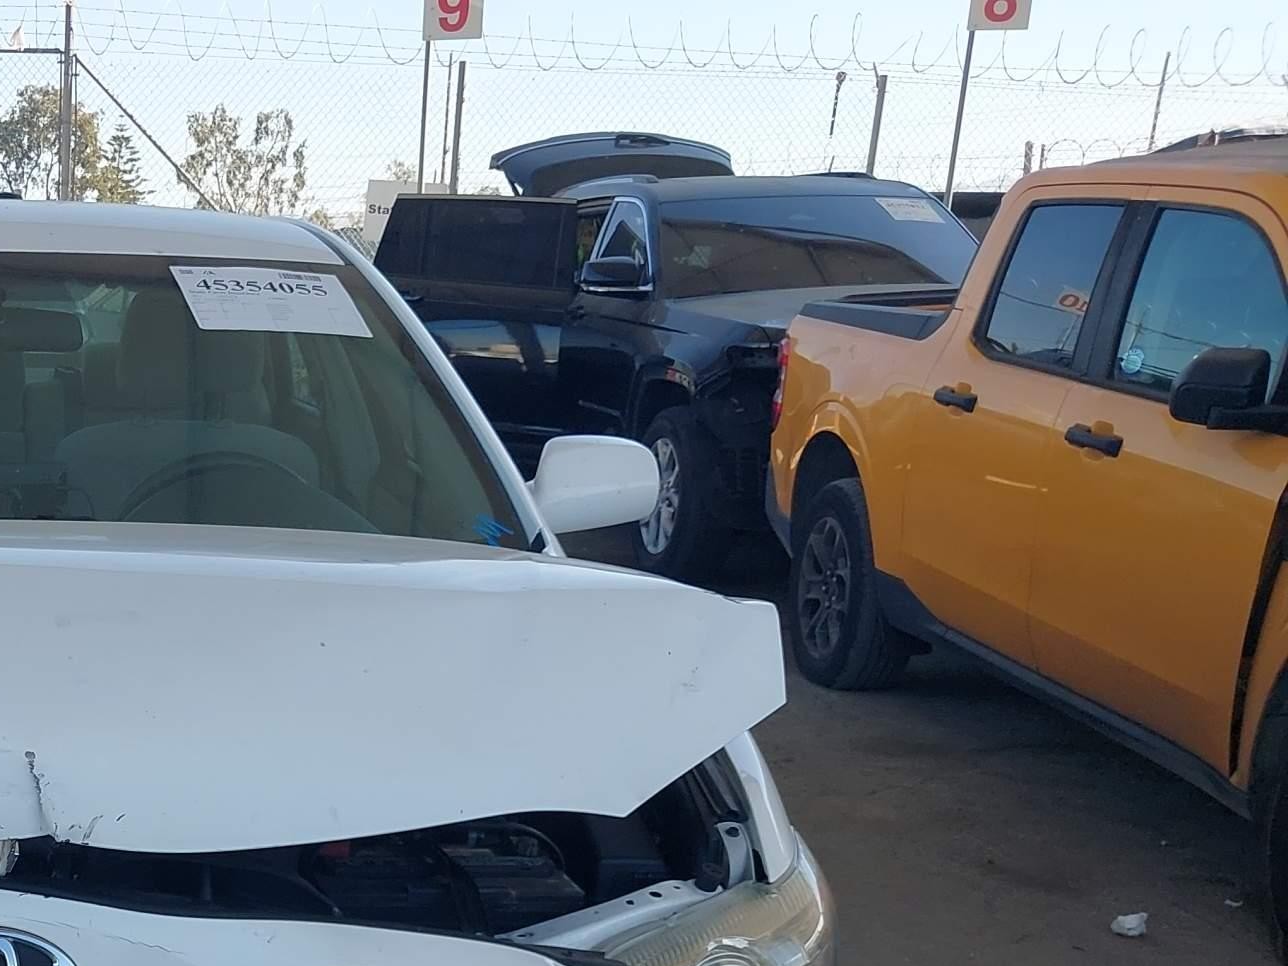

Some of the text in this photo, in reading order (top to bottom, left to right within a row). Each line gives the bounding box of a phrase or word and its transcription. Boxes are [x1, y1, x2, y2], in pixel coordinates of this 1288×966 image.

[438, 0, 470, 32] 9
[368, 203, 392, 214] Sta
[196, 278, 328, 297] 45354055
